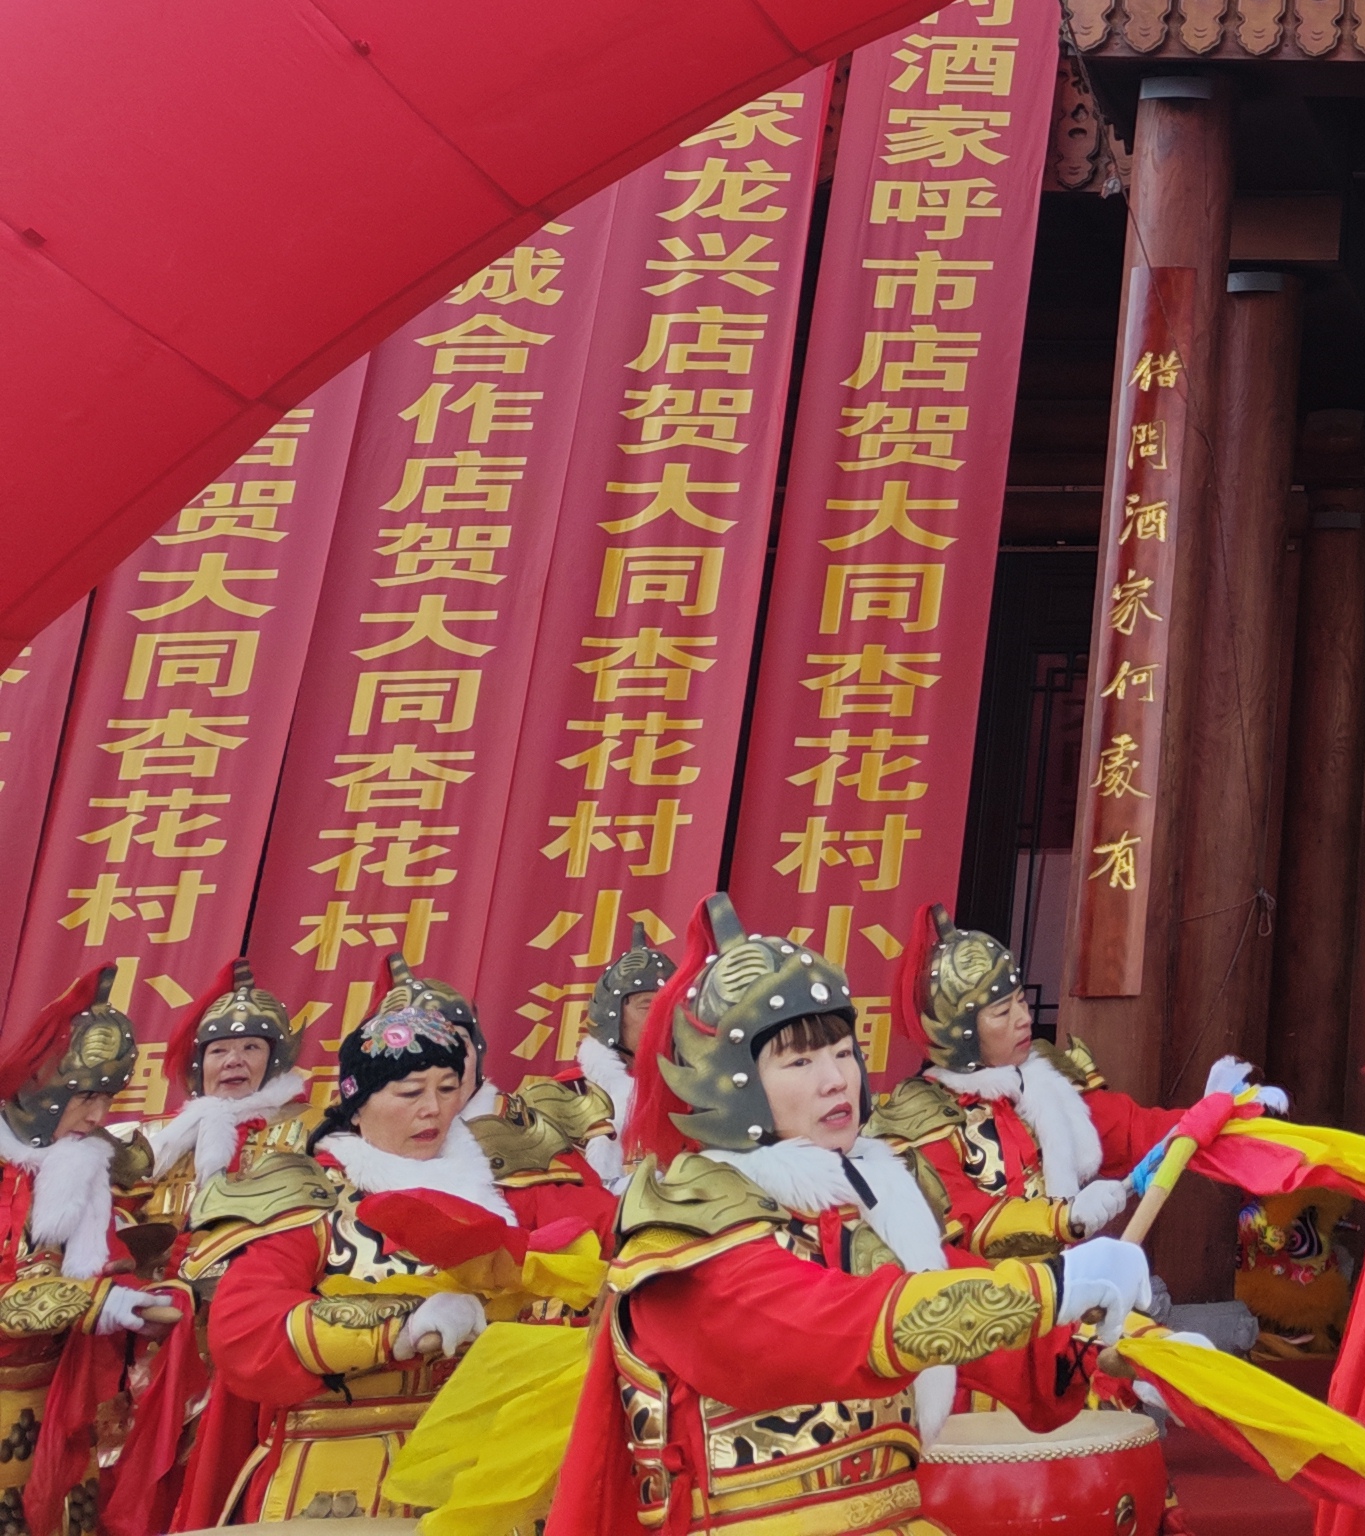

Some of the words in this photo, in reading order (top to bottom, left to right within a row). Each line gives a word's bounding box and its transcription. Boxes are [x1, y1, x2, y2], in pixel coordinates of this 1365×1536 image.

[1087, 349, 1184, 891] 借問酒家何處有
